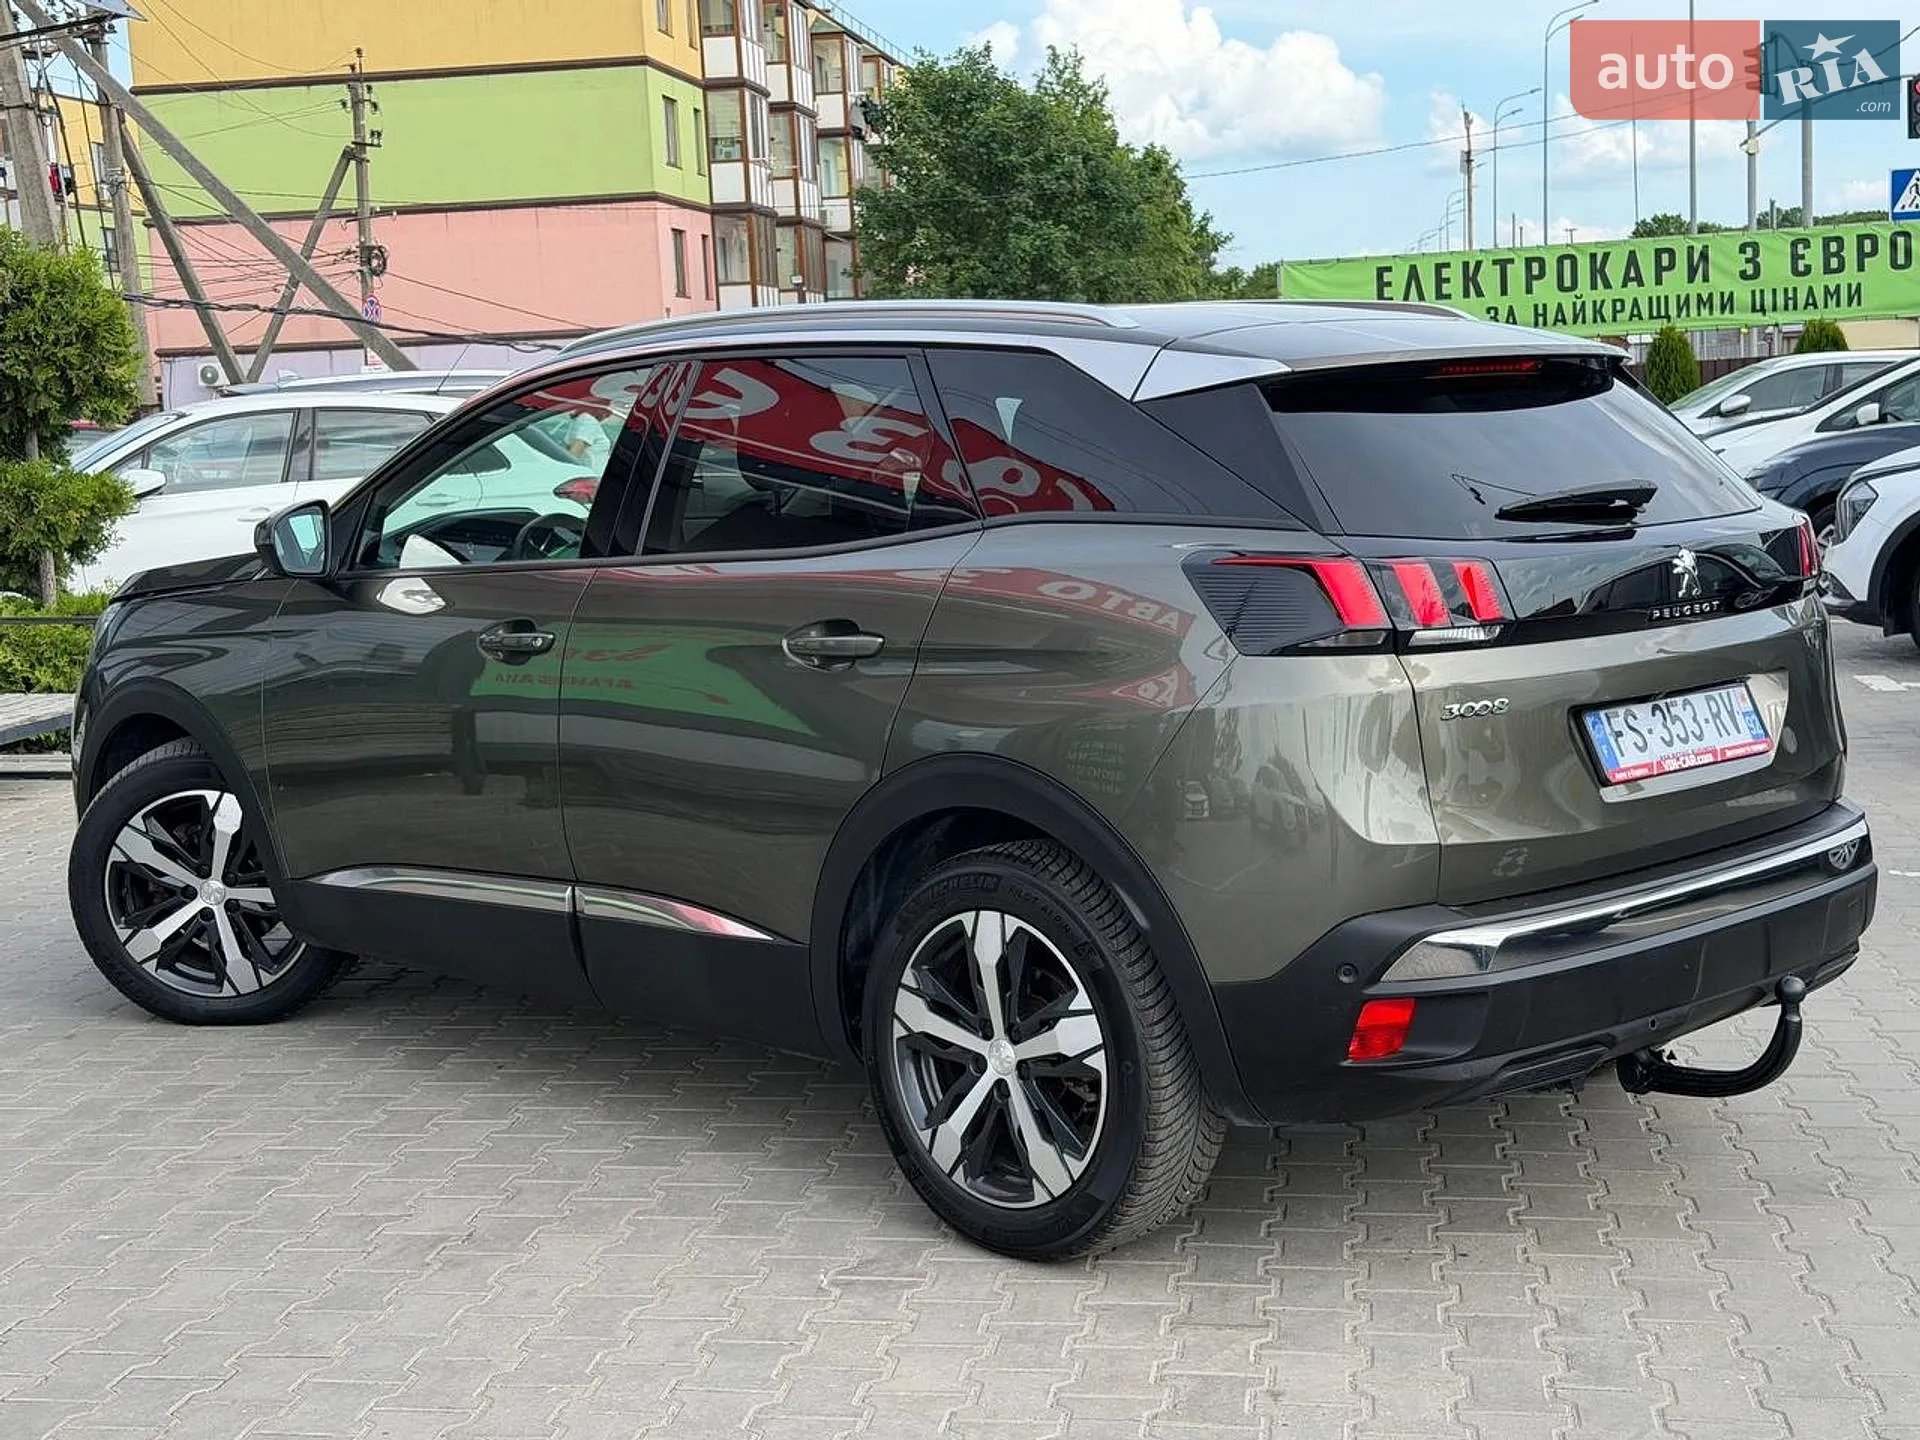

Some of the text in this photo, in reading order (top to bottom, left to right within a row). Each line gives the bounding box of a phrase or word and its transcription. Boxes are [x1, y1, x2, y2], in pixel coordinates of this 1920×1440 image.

[1375, 244, 1711, 301] ЕЛЕКТРОКАРИ
[1789, 230, 1913, 278] ЄВРО
[1485, 282, 1863, 328] ЗА НАЙКРАЩИМИ ЦІНАМИ
[1652, 600, 1720, 620] PEUGEOT
[1440, 698, 1509, 721] 3008
[1603, 691, 1741, 758] FS-353-RV
